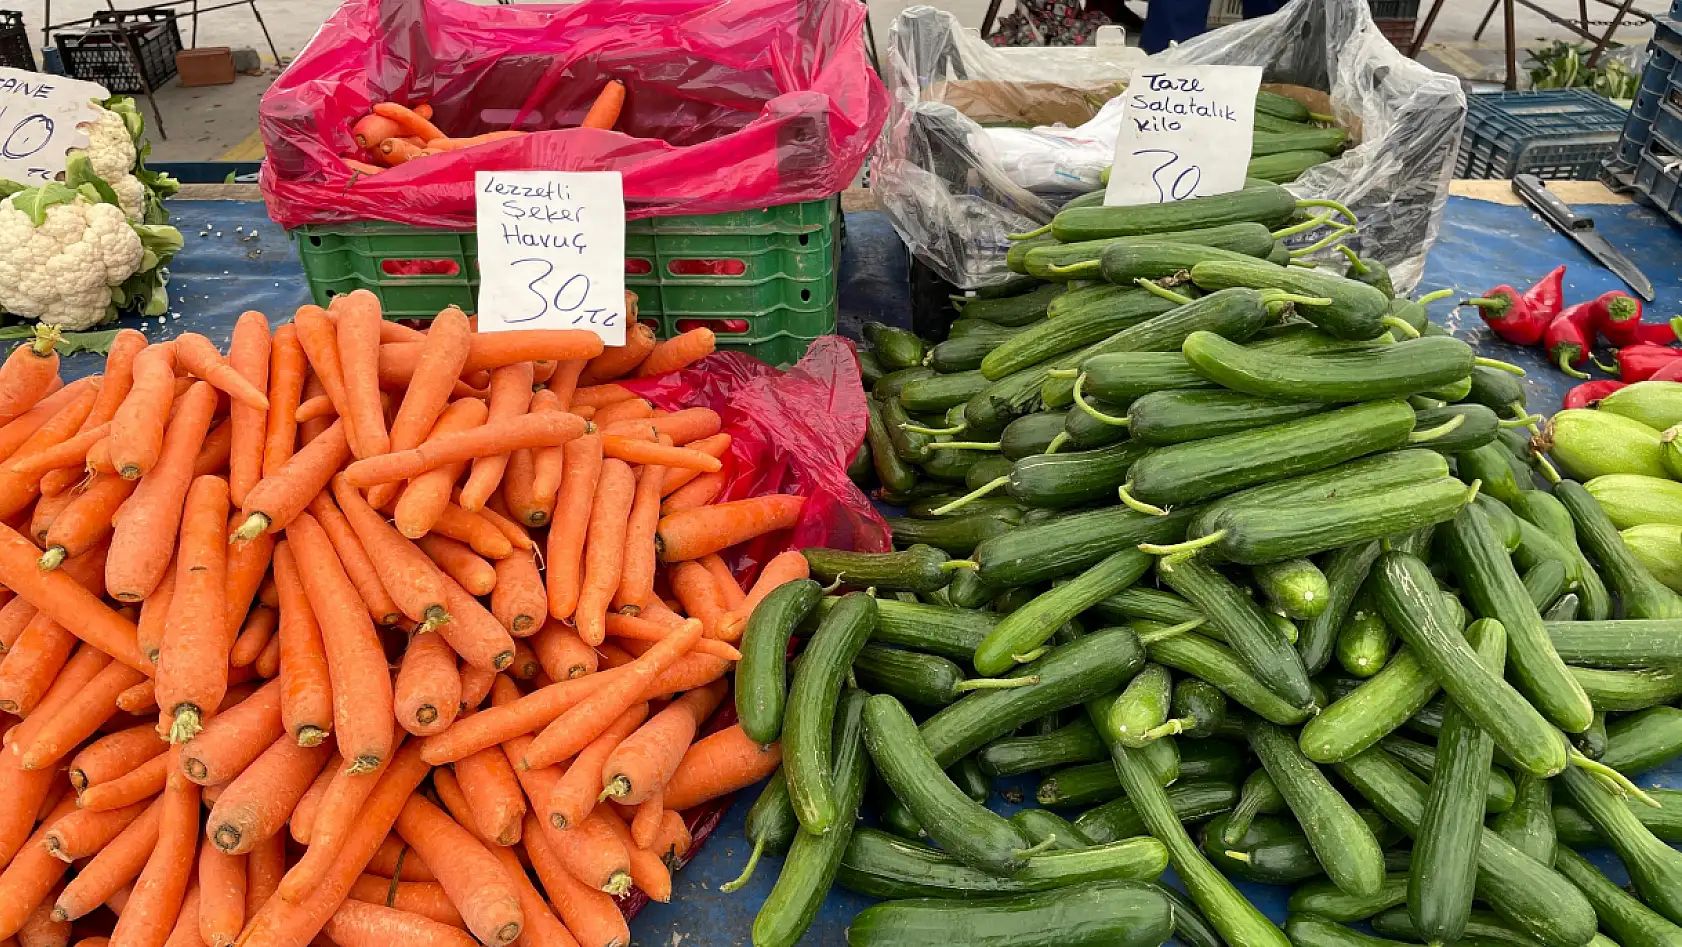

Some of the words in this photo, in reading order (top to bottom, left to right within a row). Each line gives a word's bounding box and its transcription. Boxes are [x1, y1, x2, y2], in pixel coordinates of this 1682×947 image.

[1141, 72, 1205, 92] Taze
[1130, 94, 1237, 122] Salatalık
[484, 176, 572, 201] Lezzetli
[501, 223, 588, 255] Havuç
